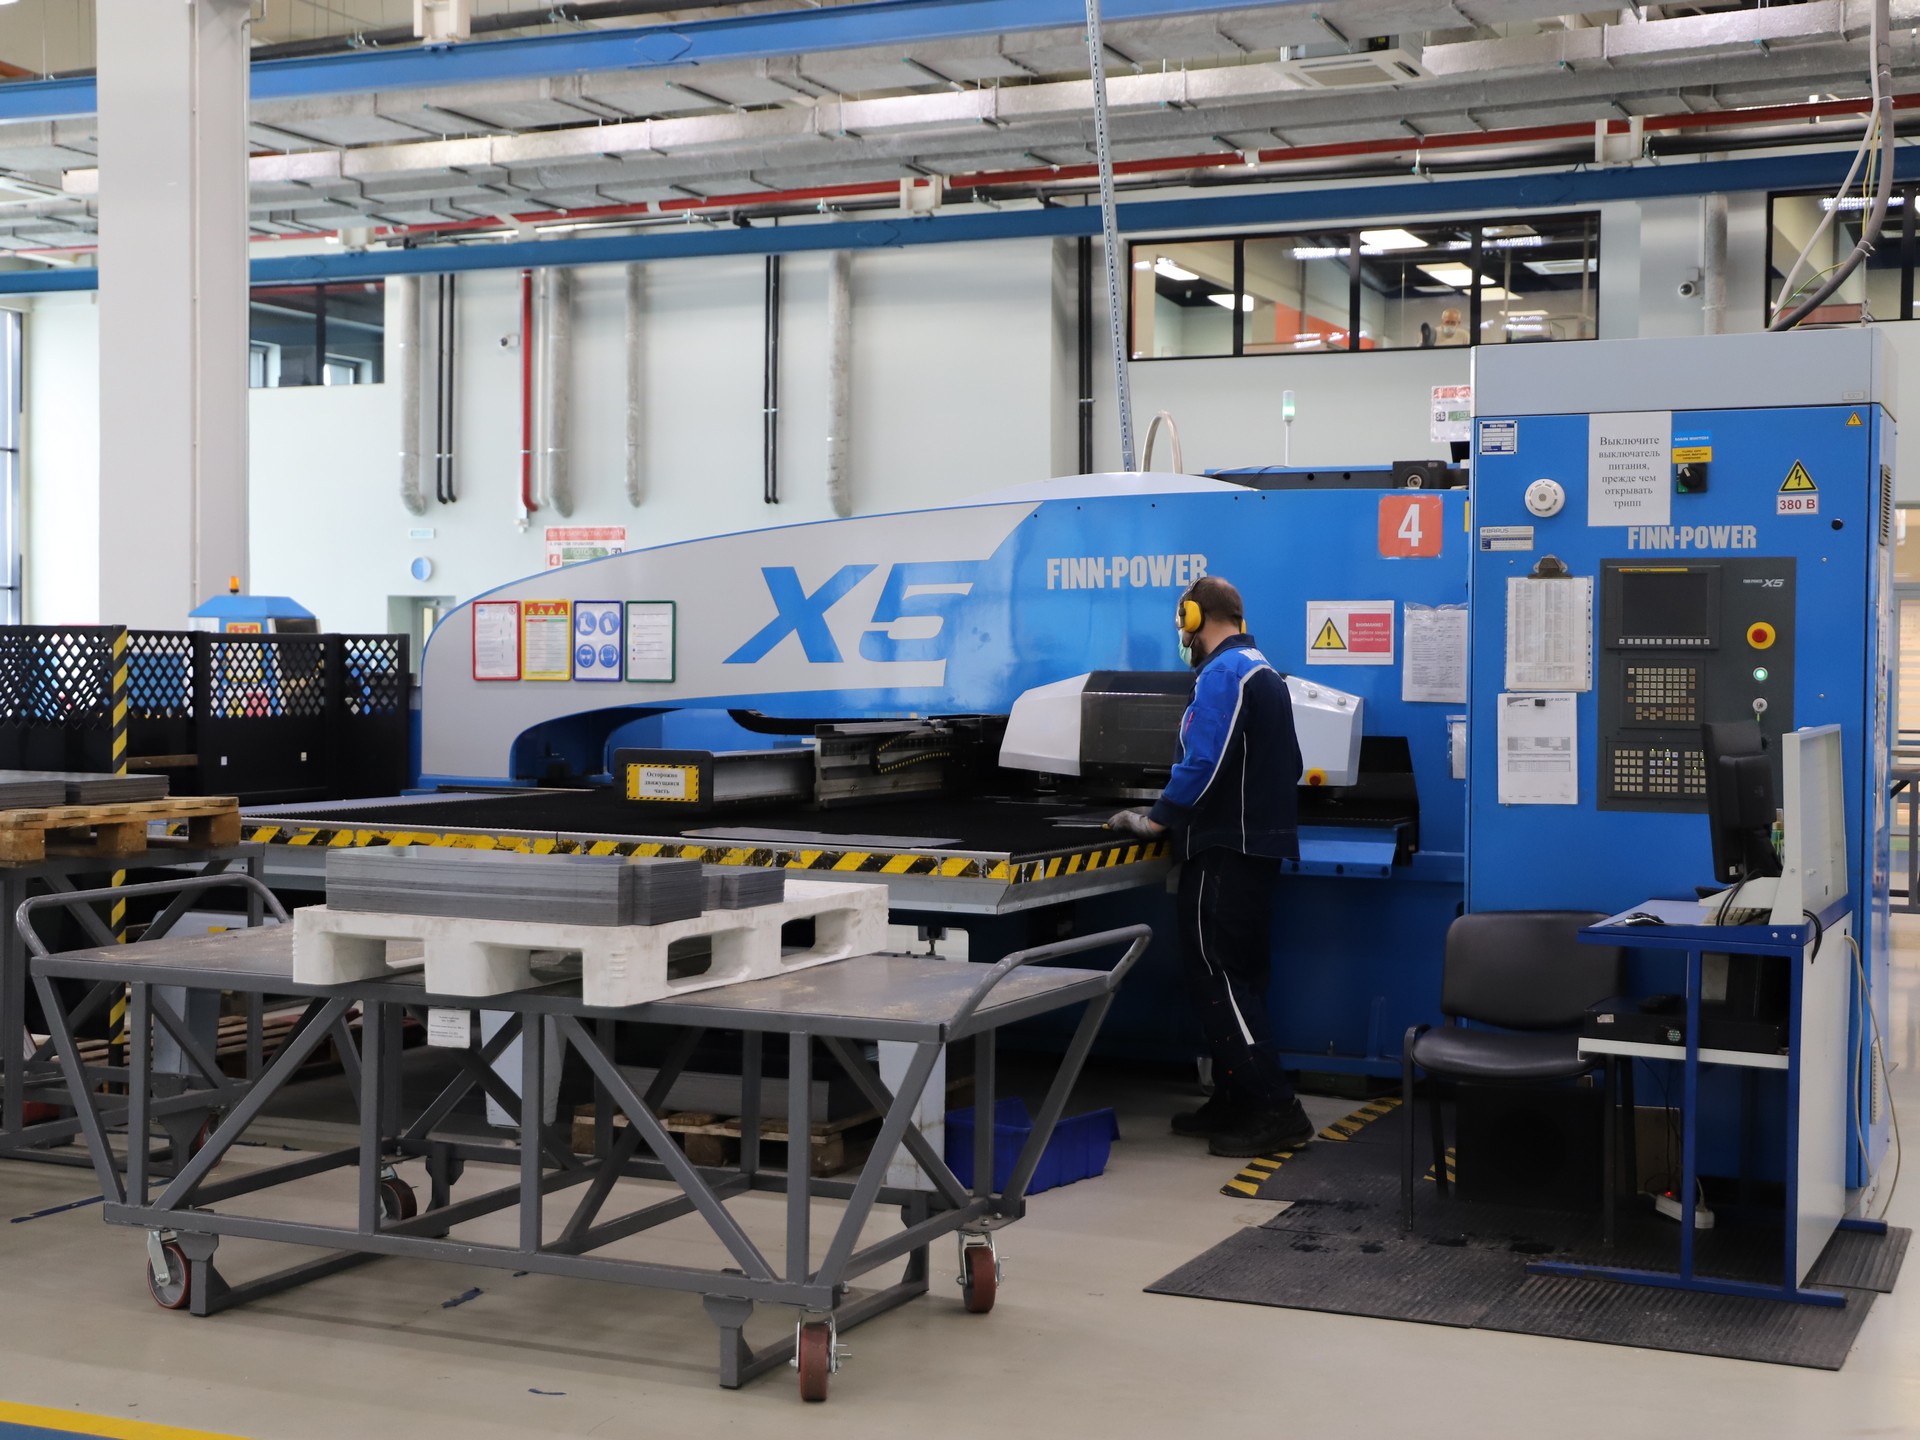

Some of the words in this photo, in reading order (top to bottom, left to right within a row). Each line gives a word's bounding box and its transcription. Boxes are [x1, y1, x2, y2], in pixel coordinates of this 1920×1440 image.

[1600, 437, 1660, 446] Выключите
[1598, 450, 1660, 458] выключатель
[1602, 476, 1636, 485] прежде
[1604, 487, 1653, 497] открывать
[1779, 500, 1802, 511] 380
[1397, 503, 1423, 547] 4
[1627, 525, 1757, 549] FINN-POWER
[551, 555, 558, 565] 4
[1047, 553, 1208, 590] FINN-POWER
[1761, 579, 1785, 588] X5
[722, 559, 980, 664] X5
[646, 771, 678, 779] Осторожно
